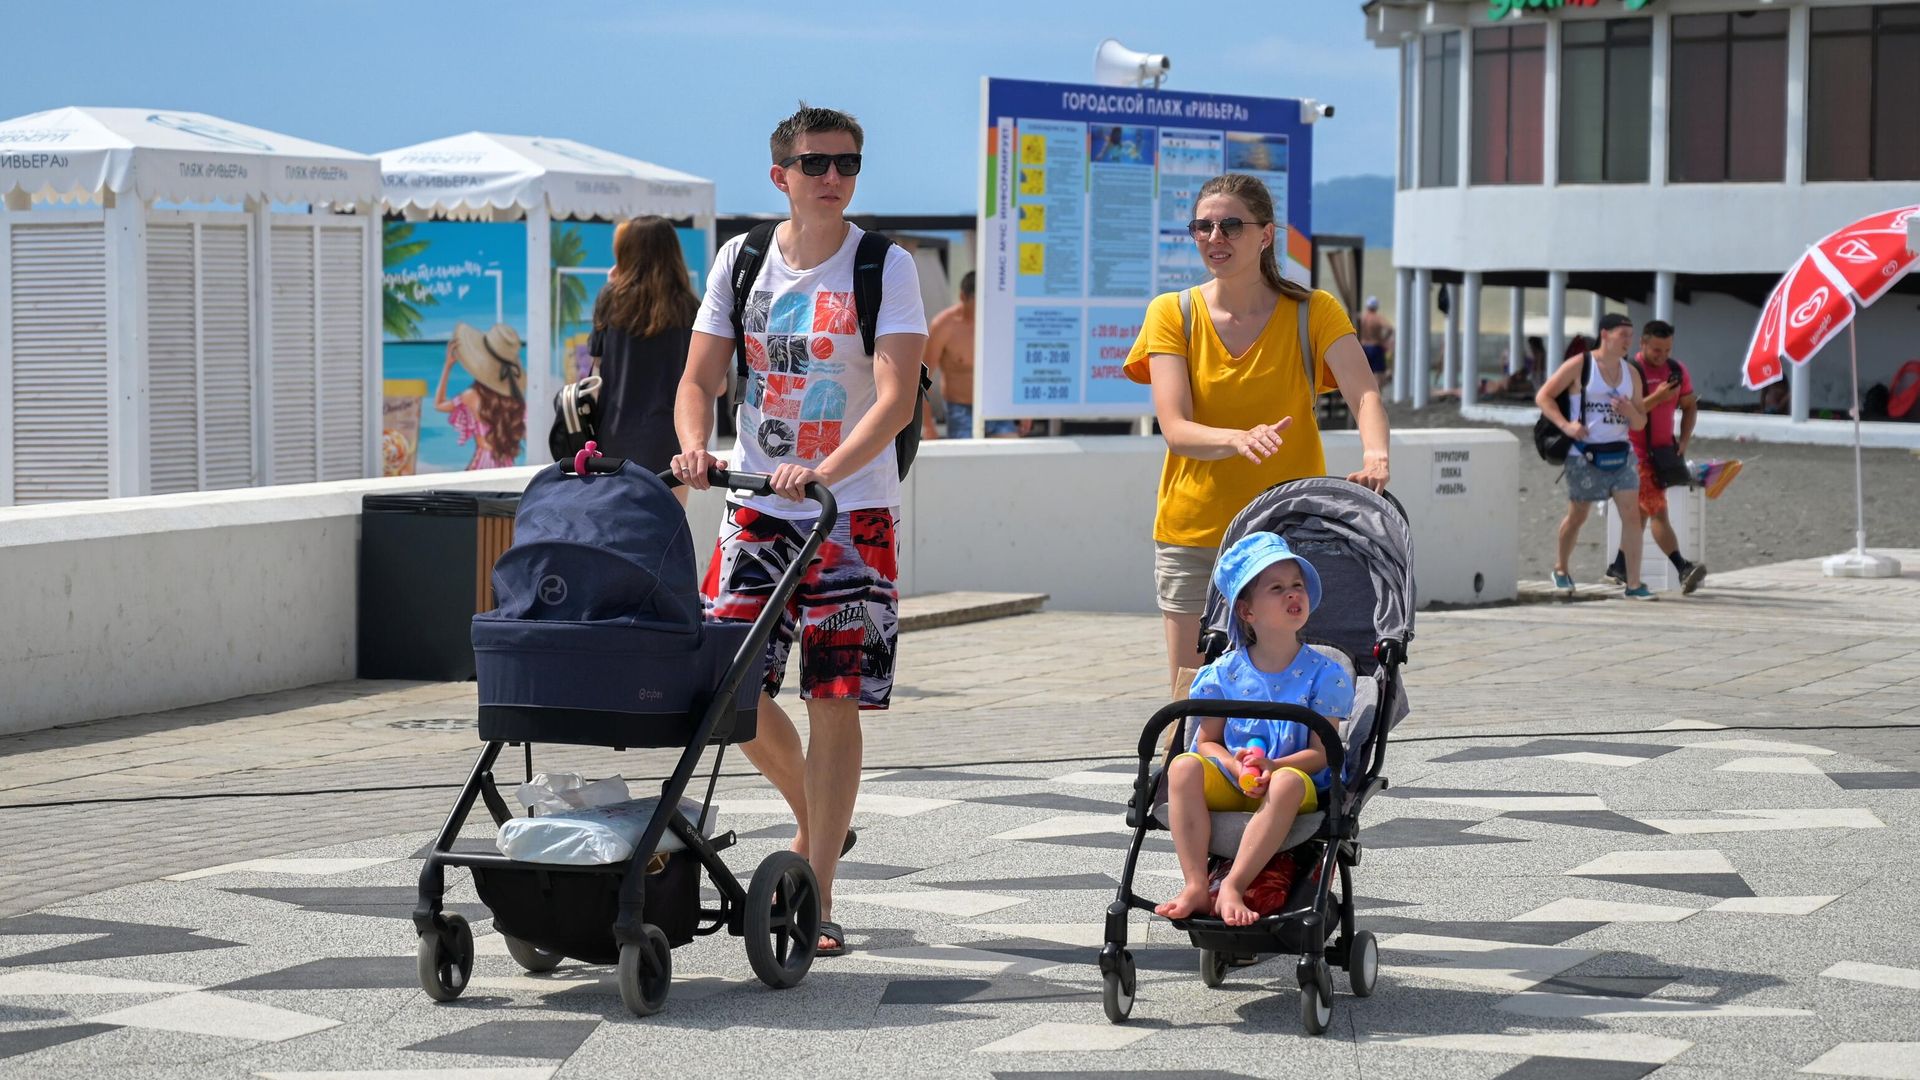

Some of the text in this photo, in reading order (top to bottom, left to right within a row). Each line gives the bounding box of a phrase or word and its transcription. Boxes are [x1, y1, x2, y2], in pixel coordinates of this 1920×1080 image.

[1062, 92, 1249, 121] ГОРОДСКОЙ ПЛЯЖ «РИВЬЕРА»
[179, 162, 203, 177] ПЛЯЖ
[285, 165, 308, 179] ПЛЯЖ
[411, 174, 485, 188] «РИВЬЕРА»
[1000, 223, 1008, 252] МЧС
[736, 269, 746, 288] THULE
[1434, 451, 1469, 463] ТЕРРИТОРИЯ
[1441, 467, 1461, 478] ПЛЯЖА
